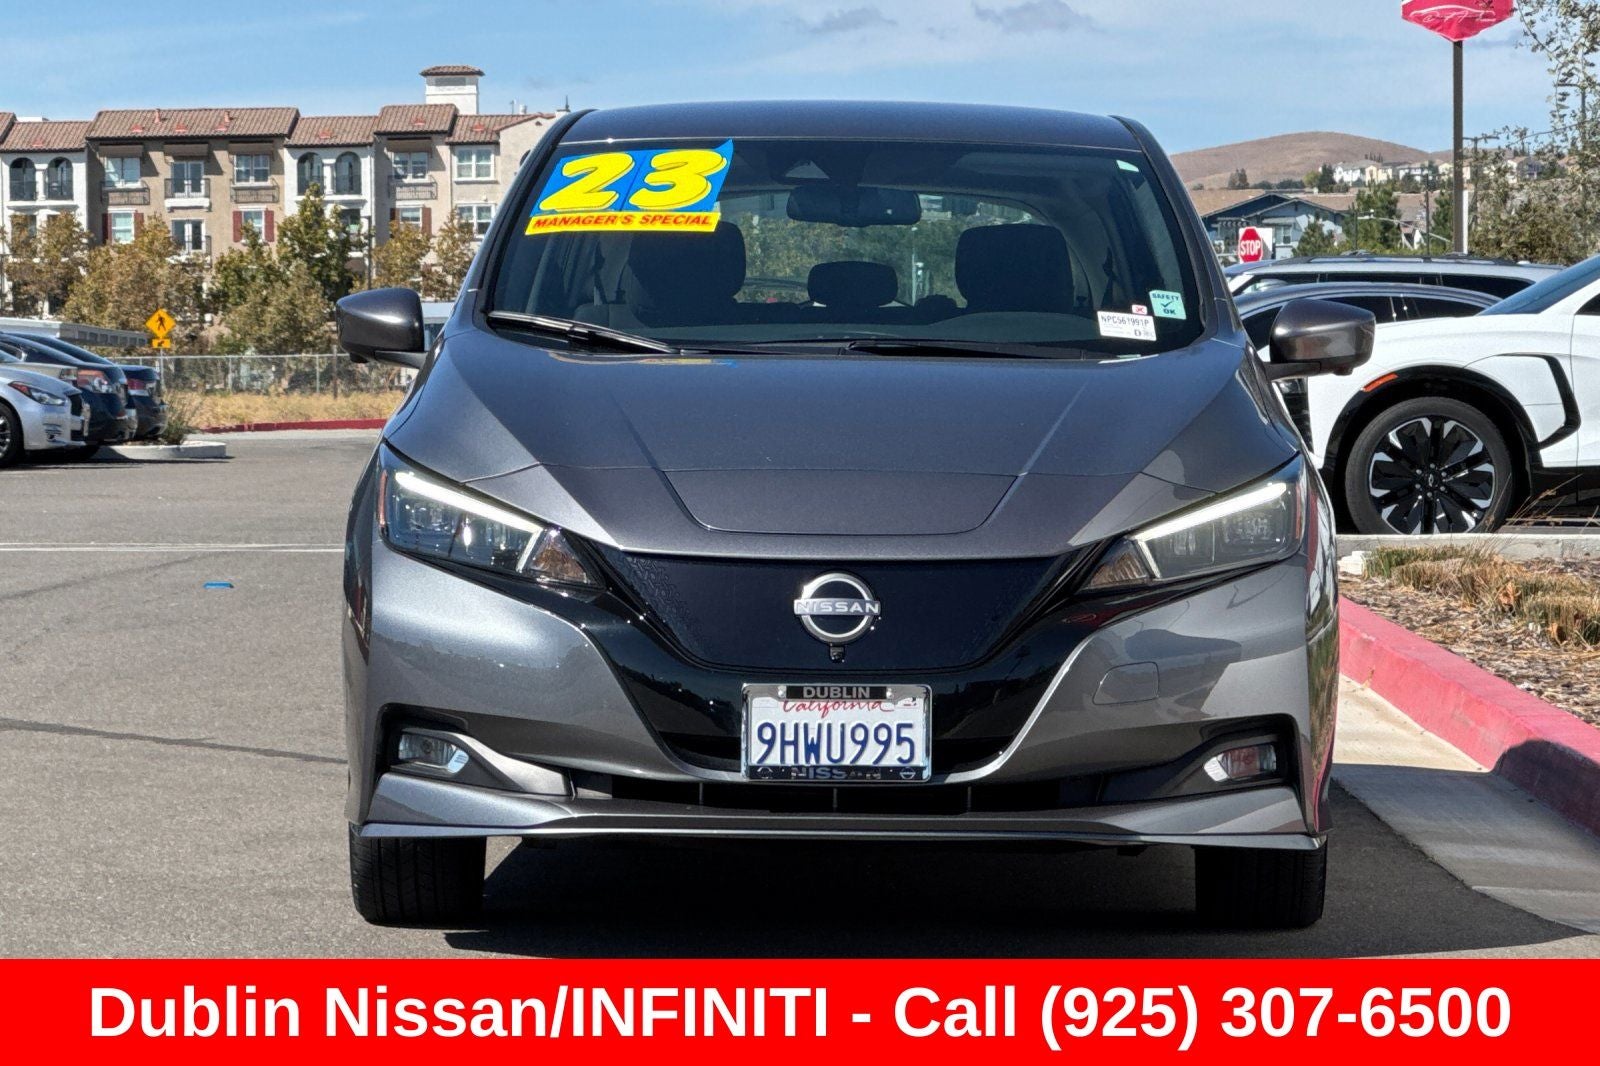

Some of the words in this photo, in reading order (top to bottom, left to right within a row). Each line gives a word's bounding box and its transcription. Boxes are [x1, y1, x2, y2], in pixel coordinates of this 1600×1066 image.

[539, 149, 727, 212] 23
[533, 214, 633, 228] MANAGER'S
[639, 214, 713, 225] SPECIAL
[1240, 239, 1261, 256] STOP
[1152, 293, 1180, 301] SAFETY
[796, 601, 880, 614] NISSAN
[803, 686, 871, 699] DUBLIN
[756, 721, 916, 765] 9HWU995
